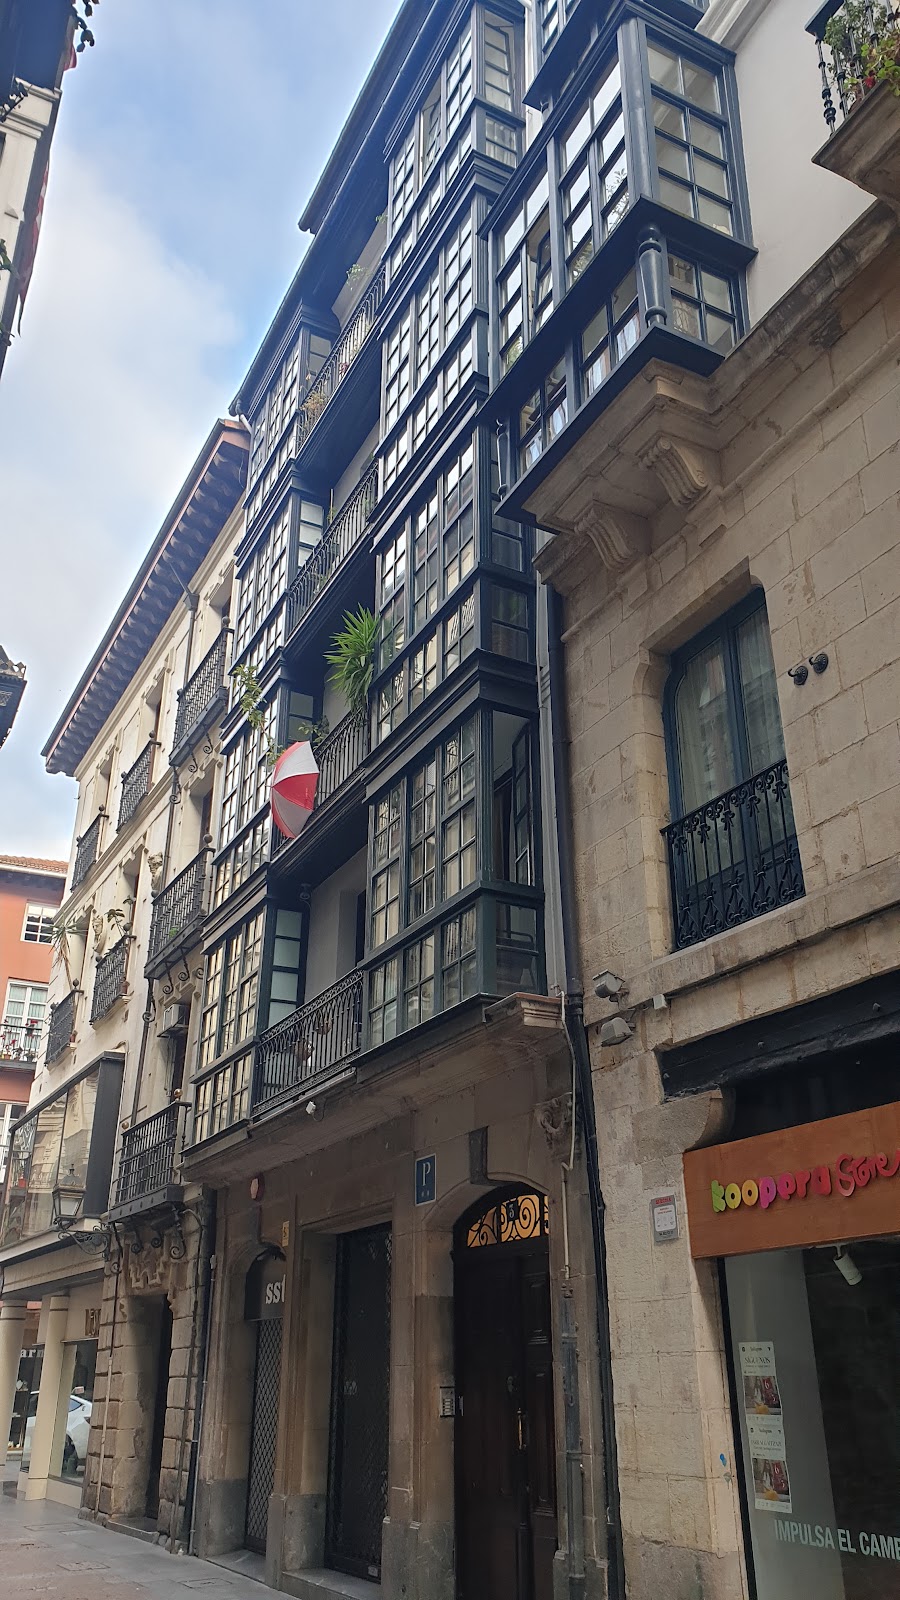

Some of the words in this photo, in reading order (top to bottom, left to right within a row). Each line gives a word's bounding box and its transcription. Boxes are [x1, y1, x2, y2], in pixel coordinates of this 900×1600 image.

[422, 1162, 431, 1186] P
[774, 1519, 836, 1550] IMPULSA
[837, 1528, 857, 1554] EL
